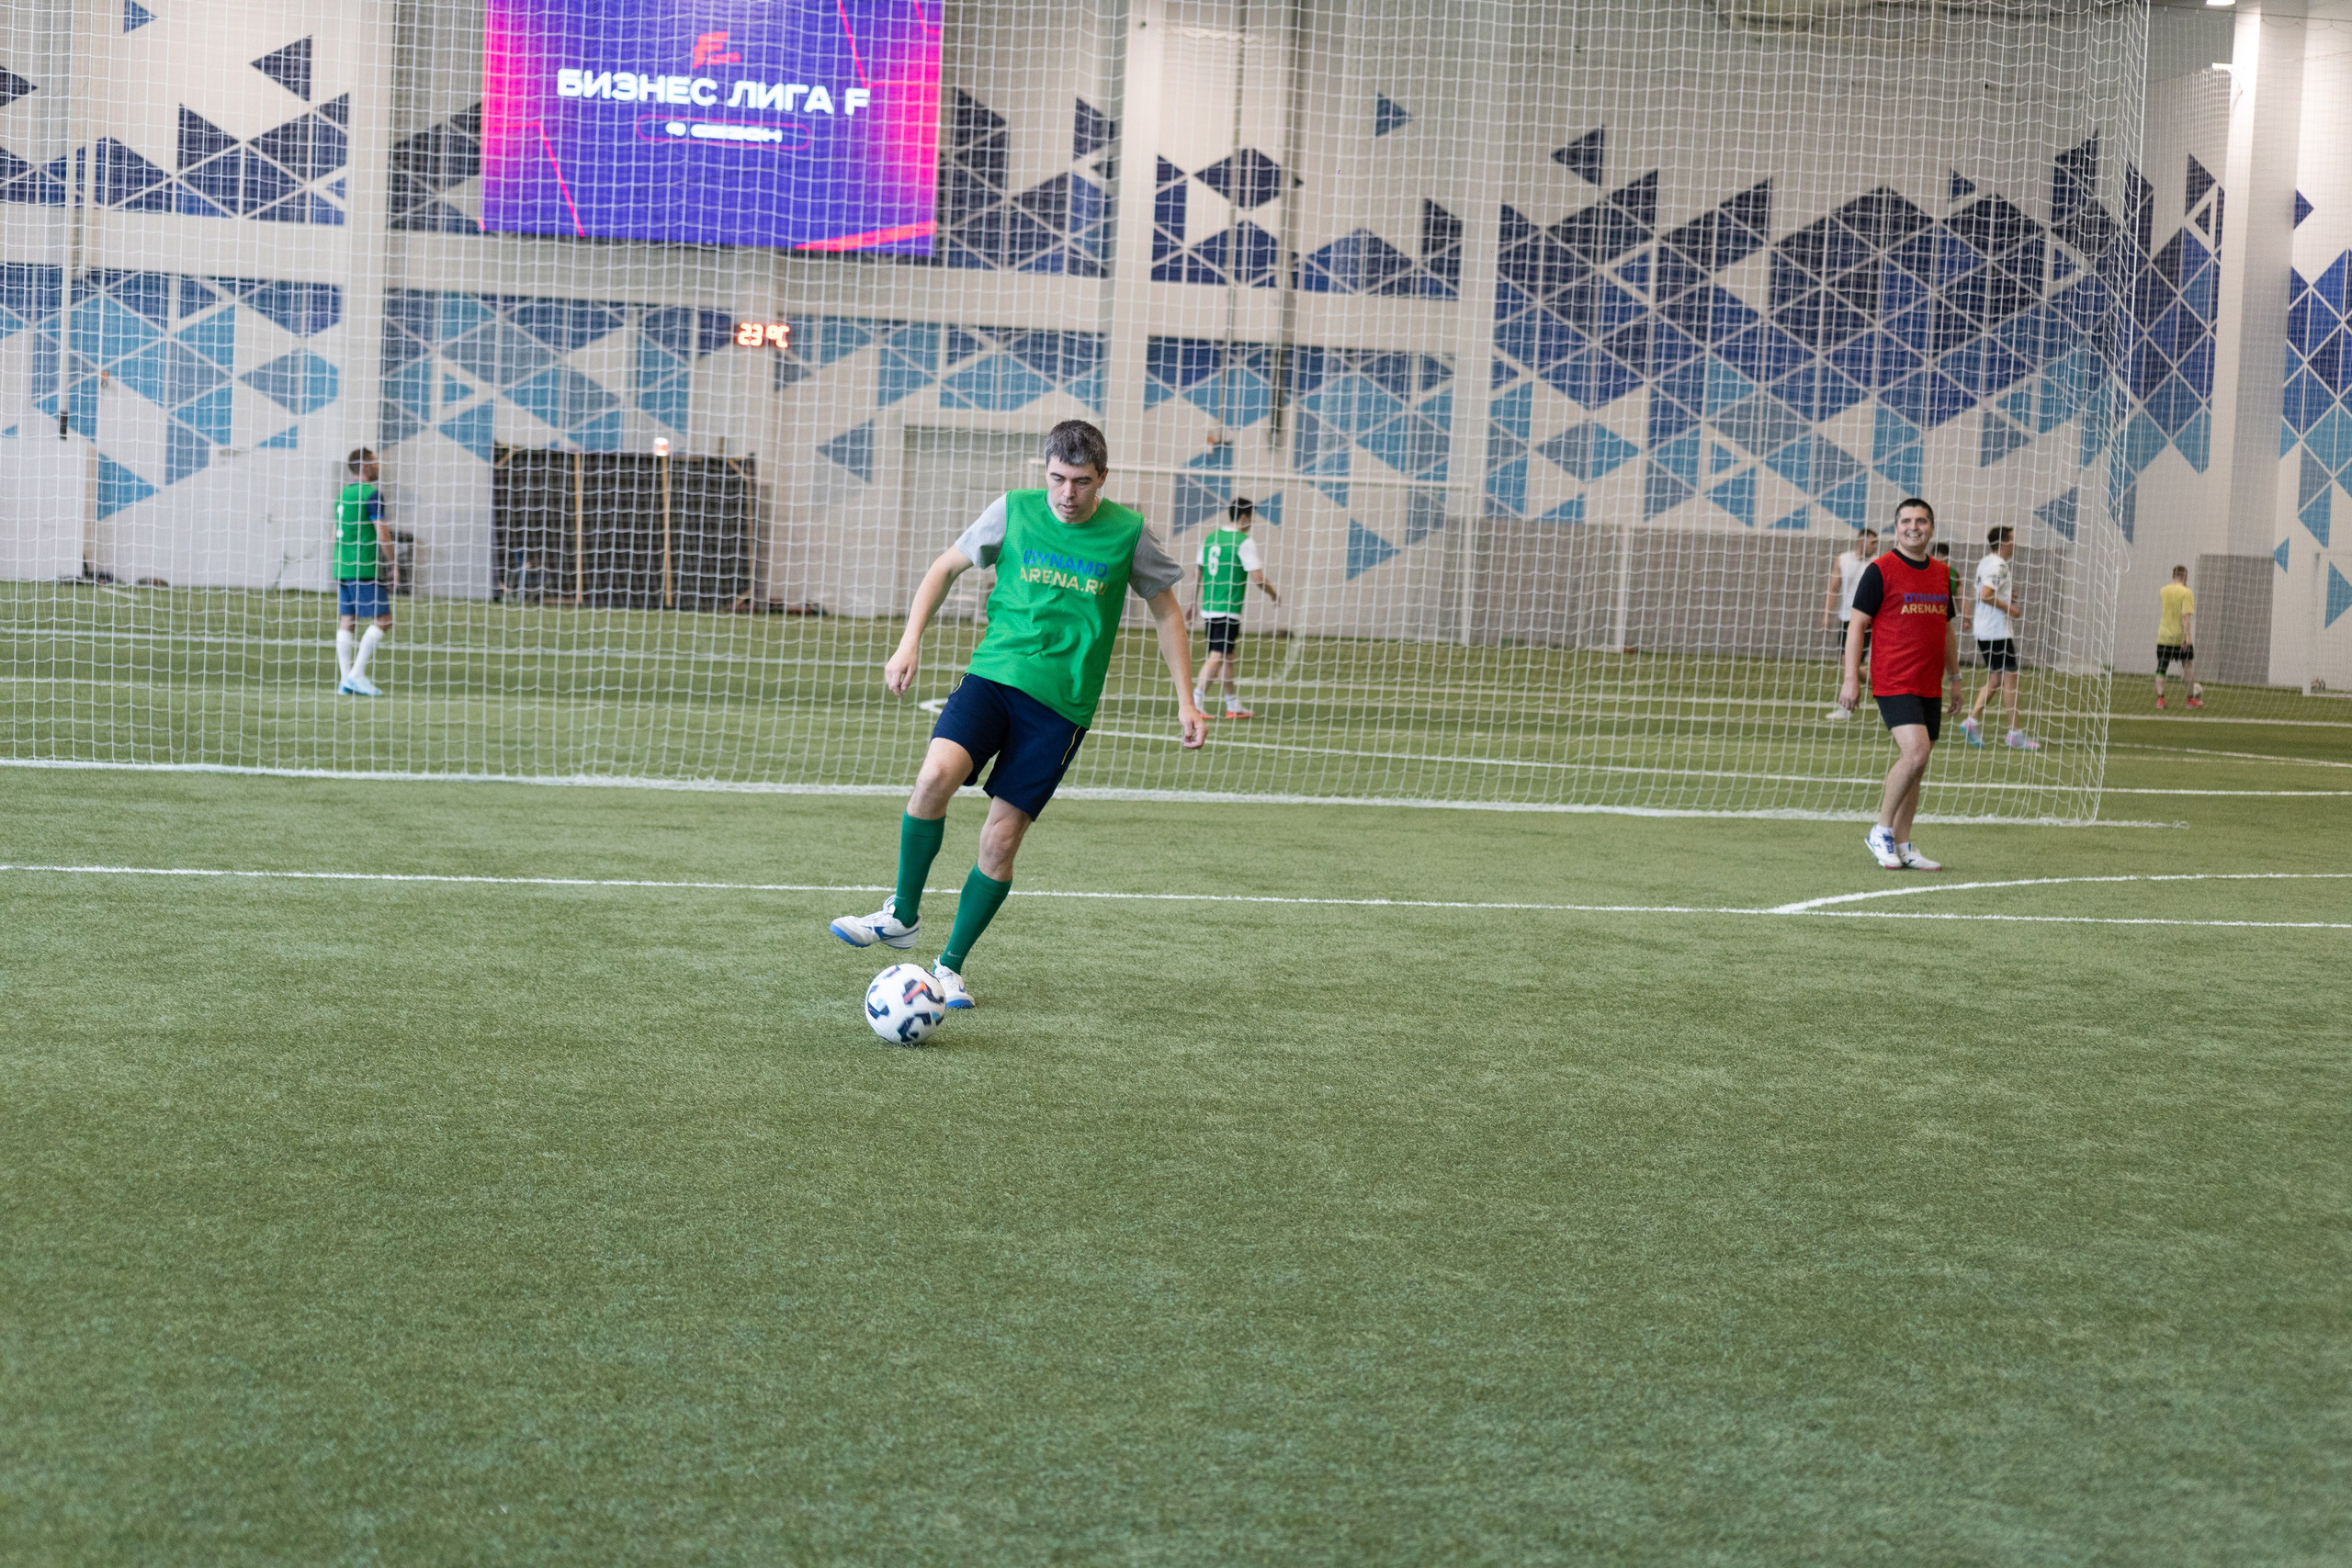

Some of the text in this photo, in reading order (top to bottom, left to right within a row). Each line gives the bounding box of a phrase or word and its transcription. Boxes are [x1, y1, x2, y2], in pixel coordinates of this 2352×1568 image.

[557, 68, 870, 116] БИЗНЕС ЛИГА F
[1023, 549, 1108, 579] DYNAMO
[1208, 546, 1221, 576] 6
[1020, 567, 1109, 595] ARENA.RU
